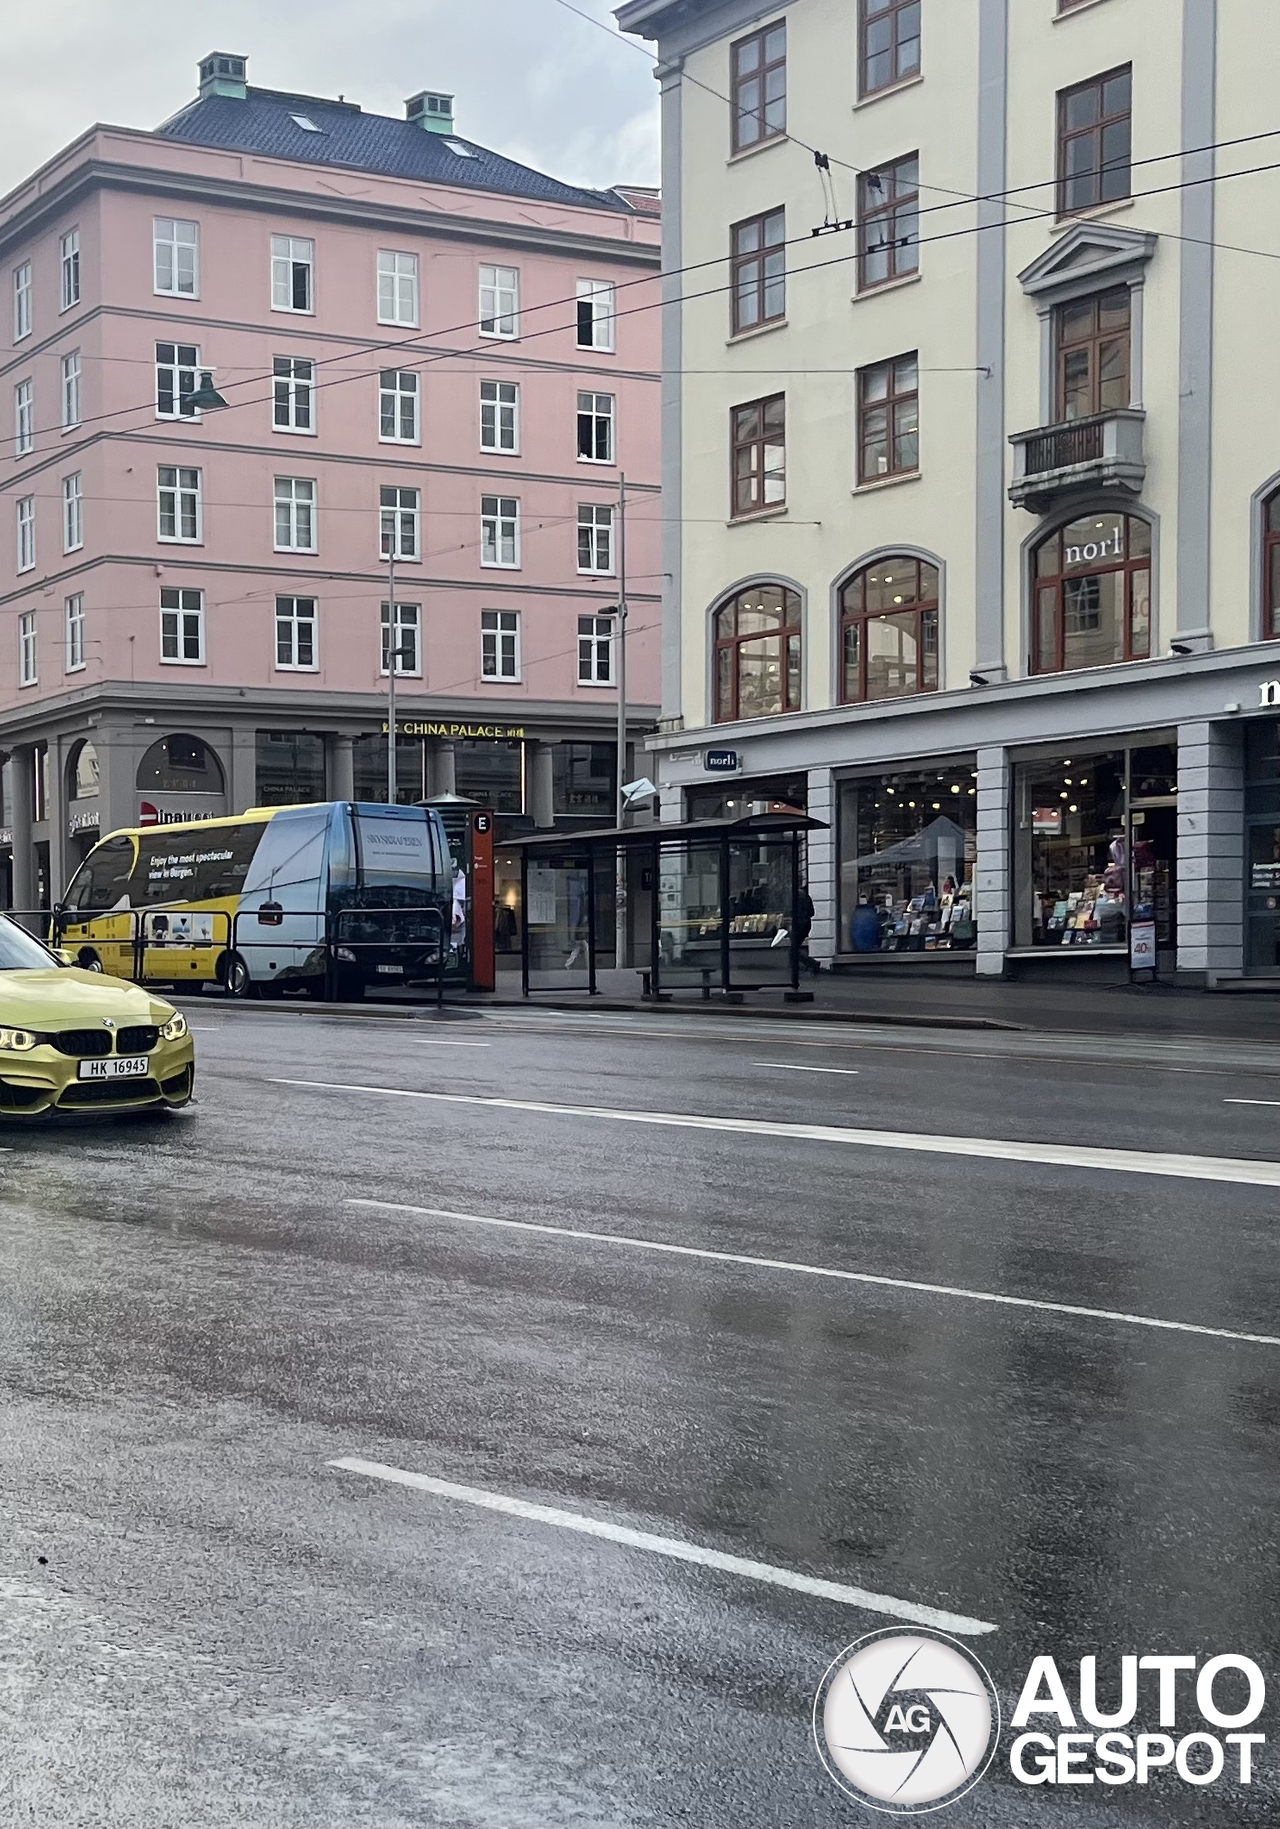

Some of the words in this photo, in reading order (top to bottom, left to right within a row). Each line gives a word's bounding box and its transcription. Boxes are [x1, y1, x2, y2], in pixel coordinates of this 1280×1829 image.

[403, 722, 448, 736] CHINA
[450, 724, 504, 738] PALACE
[709, 754, 735, 765] norli
[478, 817, 487, 830] E
[150, 855, 167, 868] Enjoy
[167, 854, 179, 865] the
[179, 853, 195, 863] most
[195, 850, 234, 864] spectacular
[148, 869, 163, 879] view
[91, 1062, 107, 1075] HK
[113, 1059, 146, 1074] 16945
